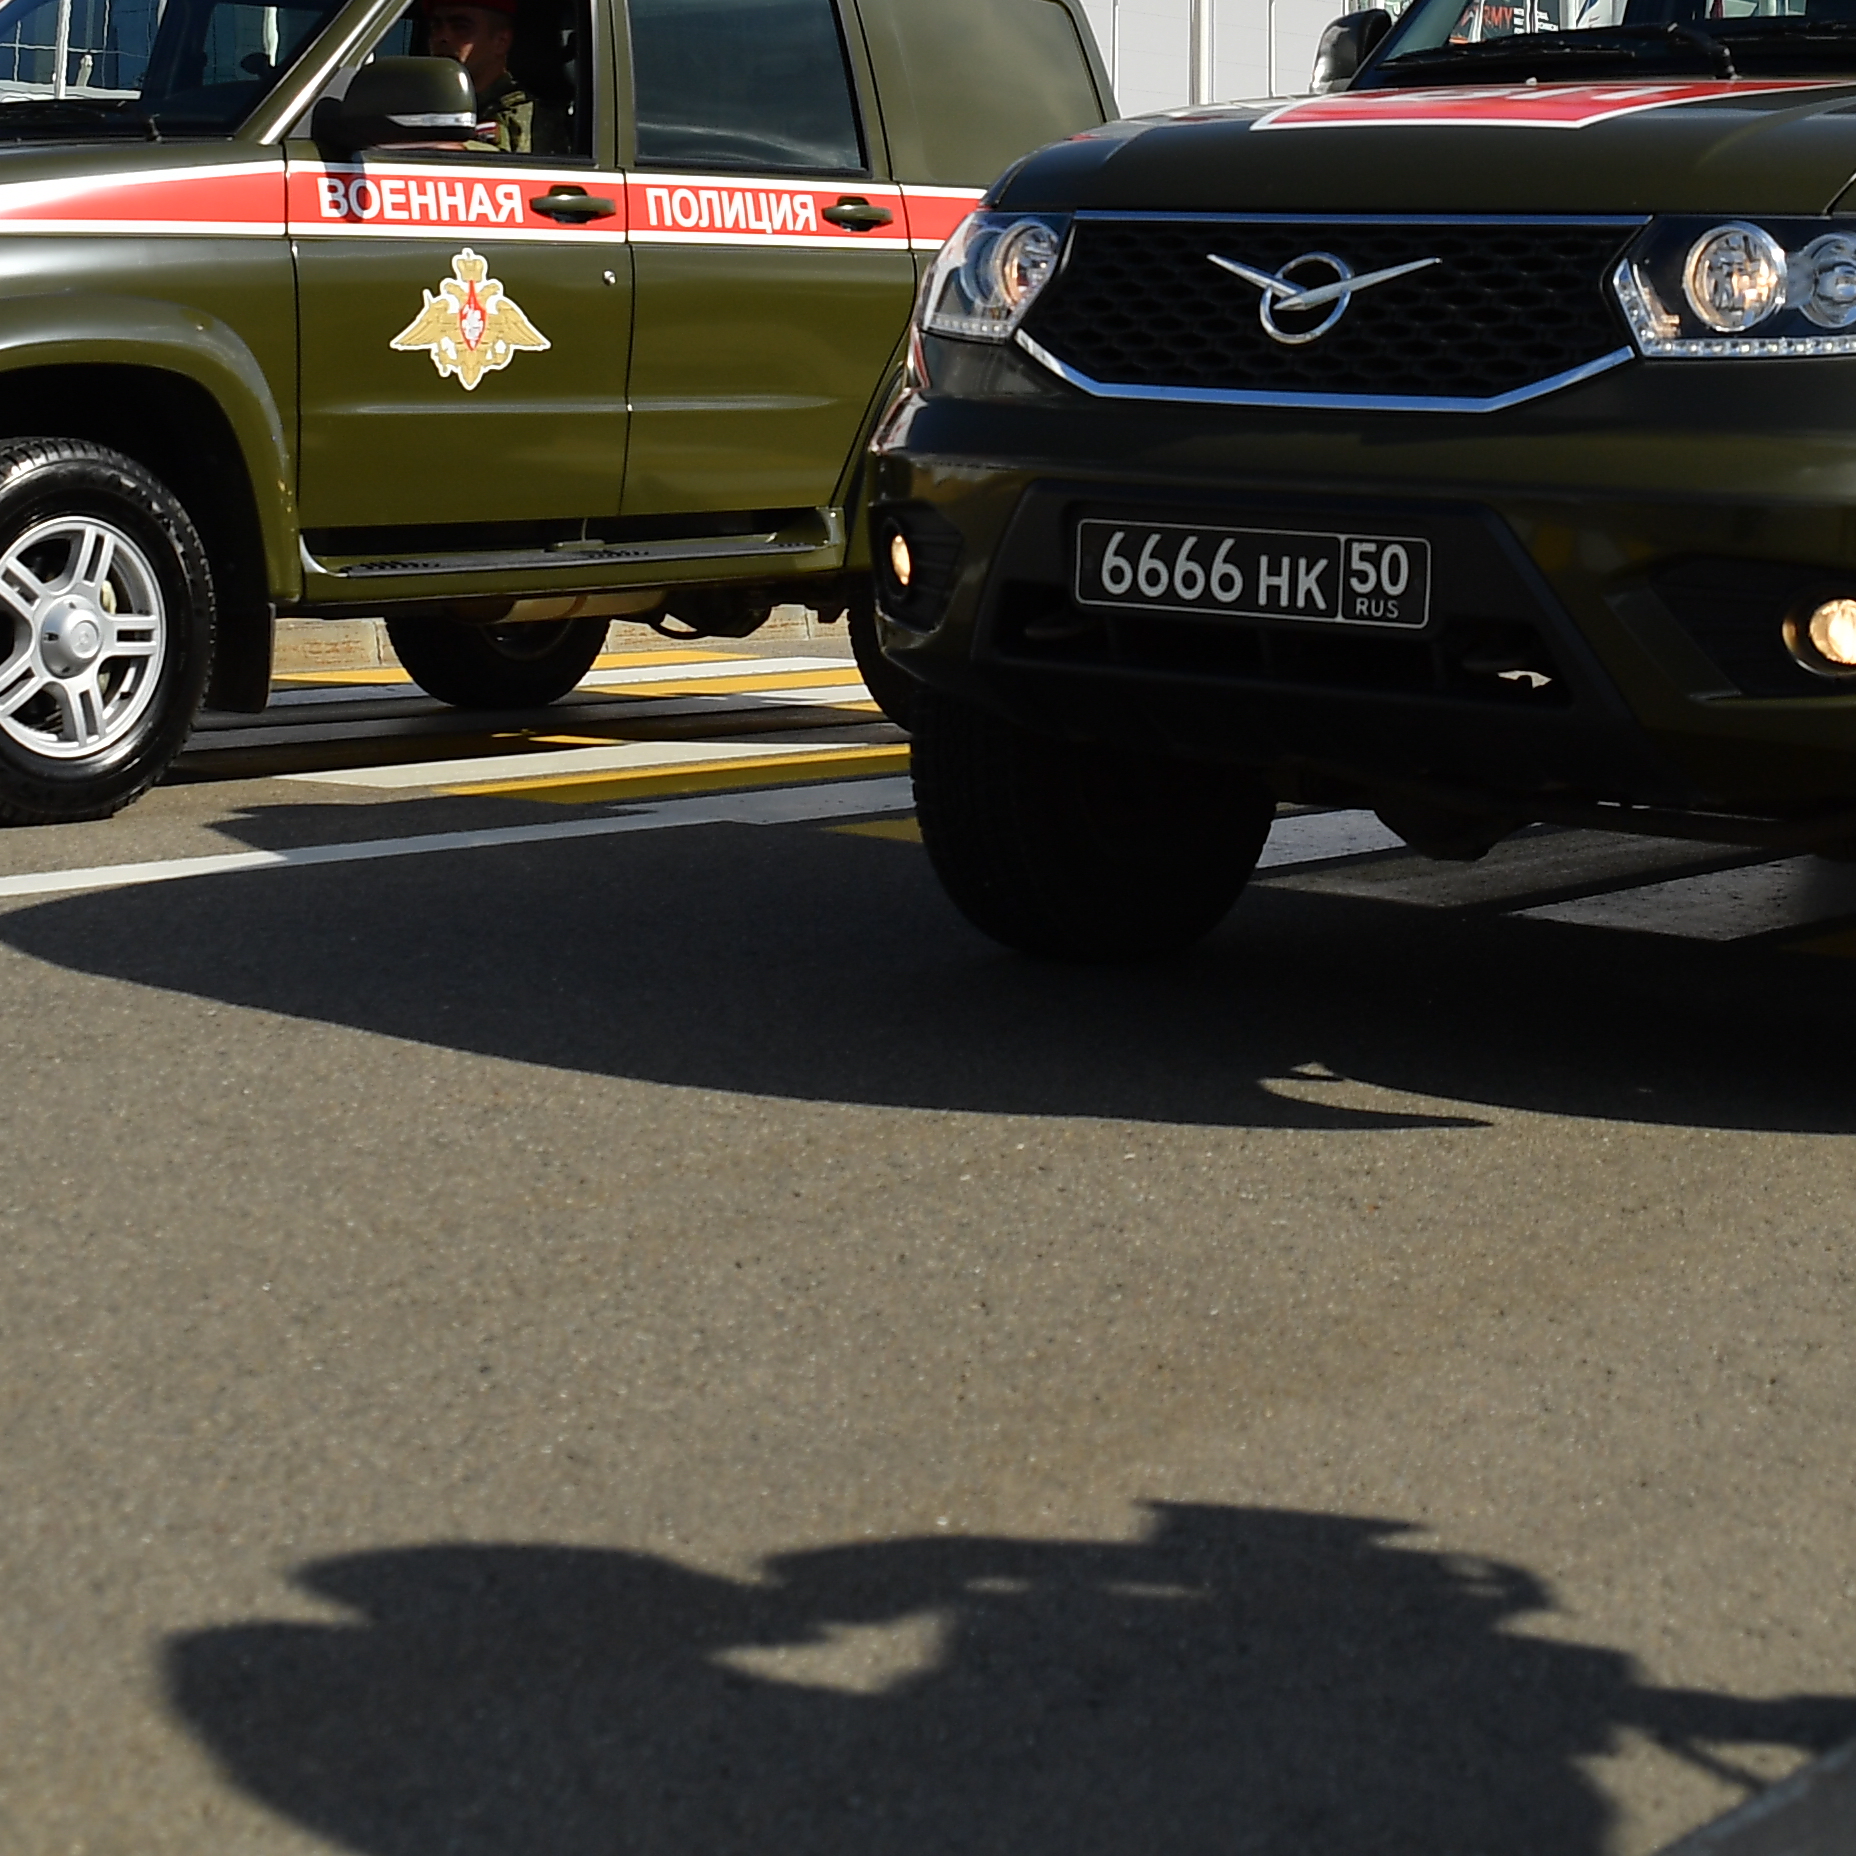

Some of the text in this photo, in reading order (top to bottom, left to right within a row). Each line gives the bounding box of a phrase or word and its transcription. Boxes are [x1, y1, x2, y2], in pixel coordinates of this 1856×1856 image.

[318, 177, 818, 234] ВОЕННАЯ ПОЛИЦИЯ
[1101, 531, 1243, 603] 6666
[1349, 543, 1409, 597] 50
[1355, 598, 1399, 620] RUS
